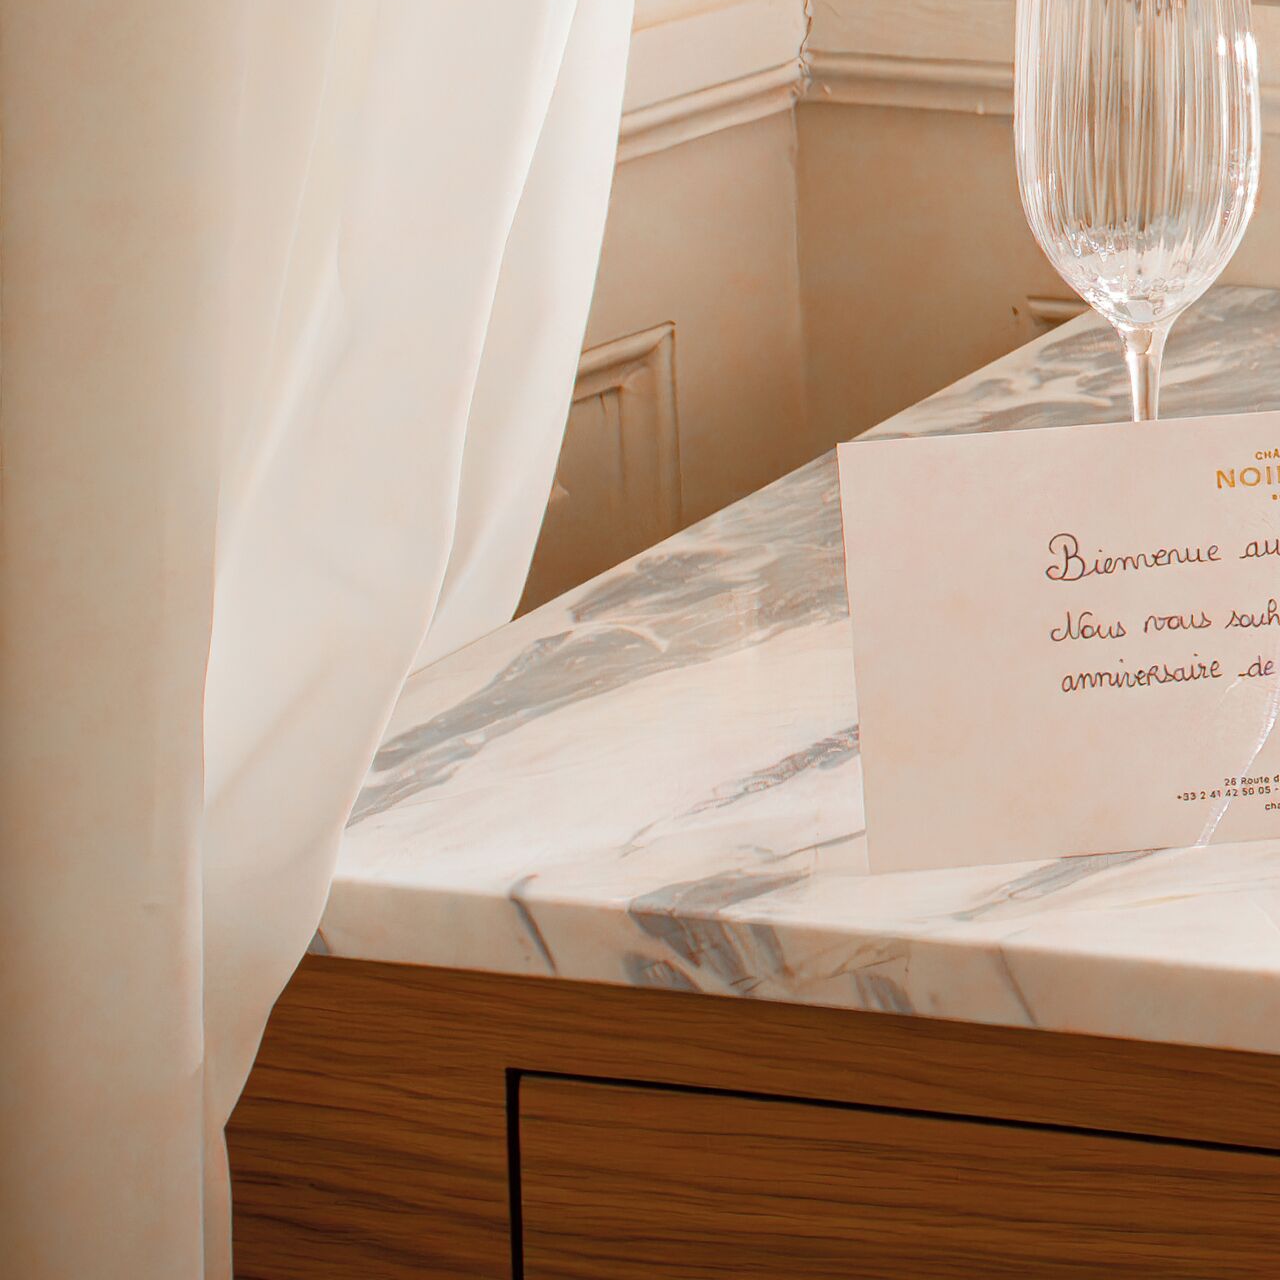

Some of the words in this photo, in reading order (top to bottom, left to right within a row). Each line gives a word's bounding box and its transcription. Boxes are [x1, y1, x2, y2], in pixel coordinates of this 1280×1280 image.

[1046, 533, 1222, 582] Bienvenue
[1050, 611, 1127, 642] Nous
[1144, 611, 1213, 634] vous
[1061, 653, 1223, 693] anniversaire
[1237, 655, 1275, 678] de
[1177, 792, 1197, 801] +33
[1200, 791, 1206, 800] 2
[1209, 790, 1221, 798] 41
[1225, 788, 1239, 797] 42
[1242, 787, 1255, 796] 50
[1241, 776, 1270, 785] Route
